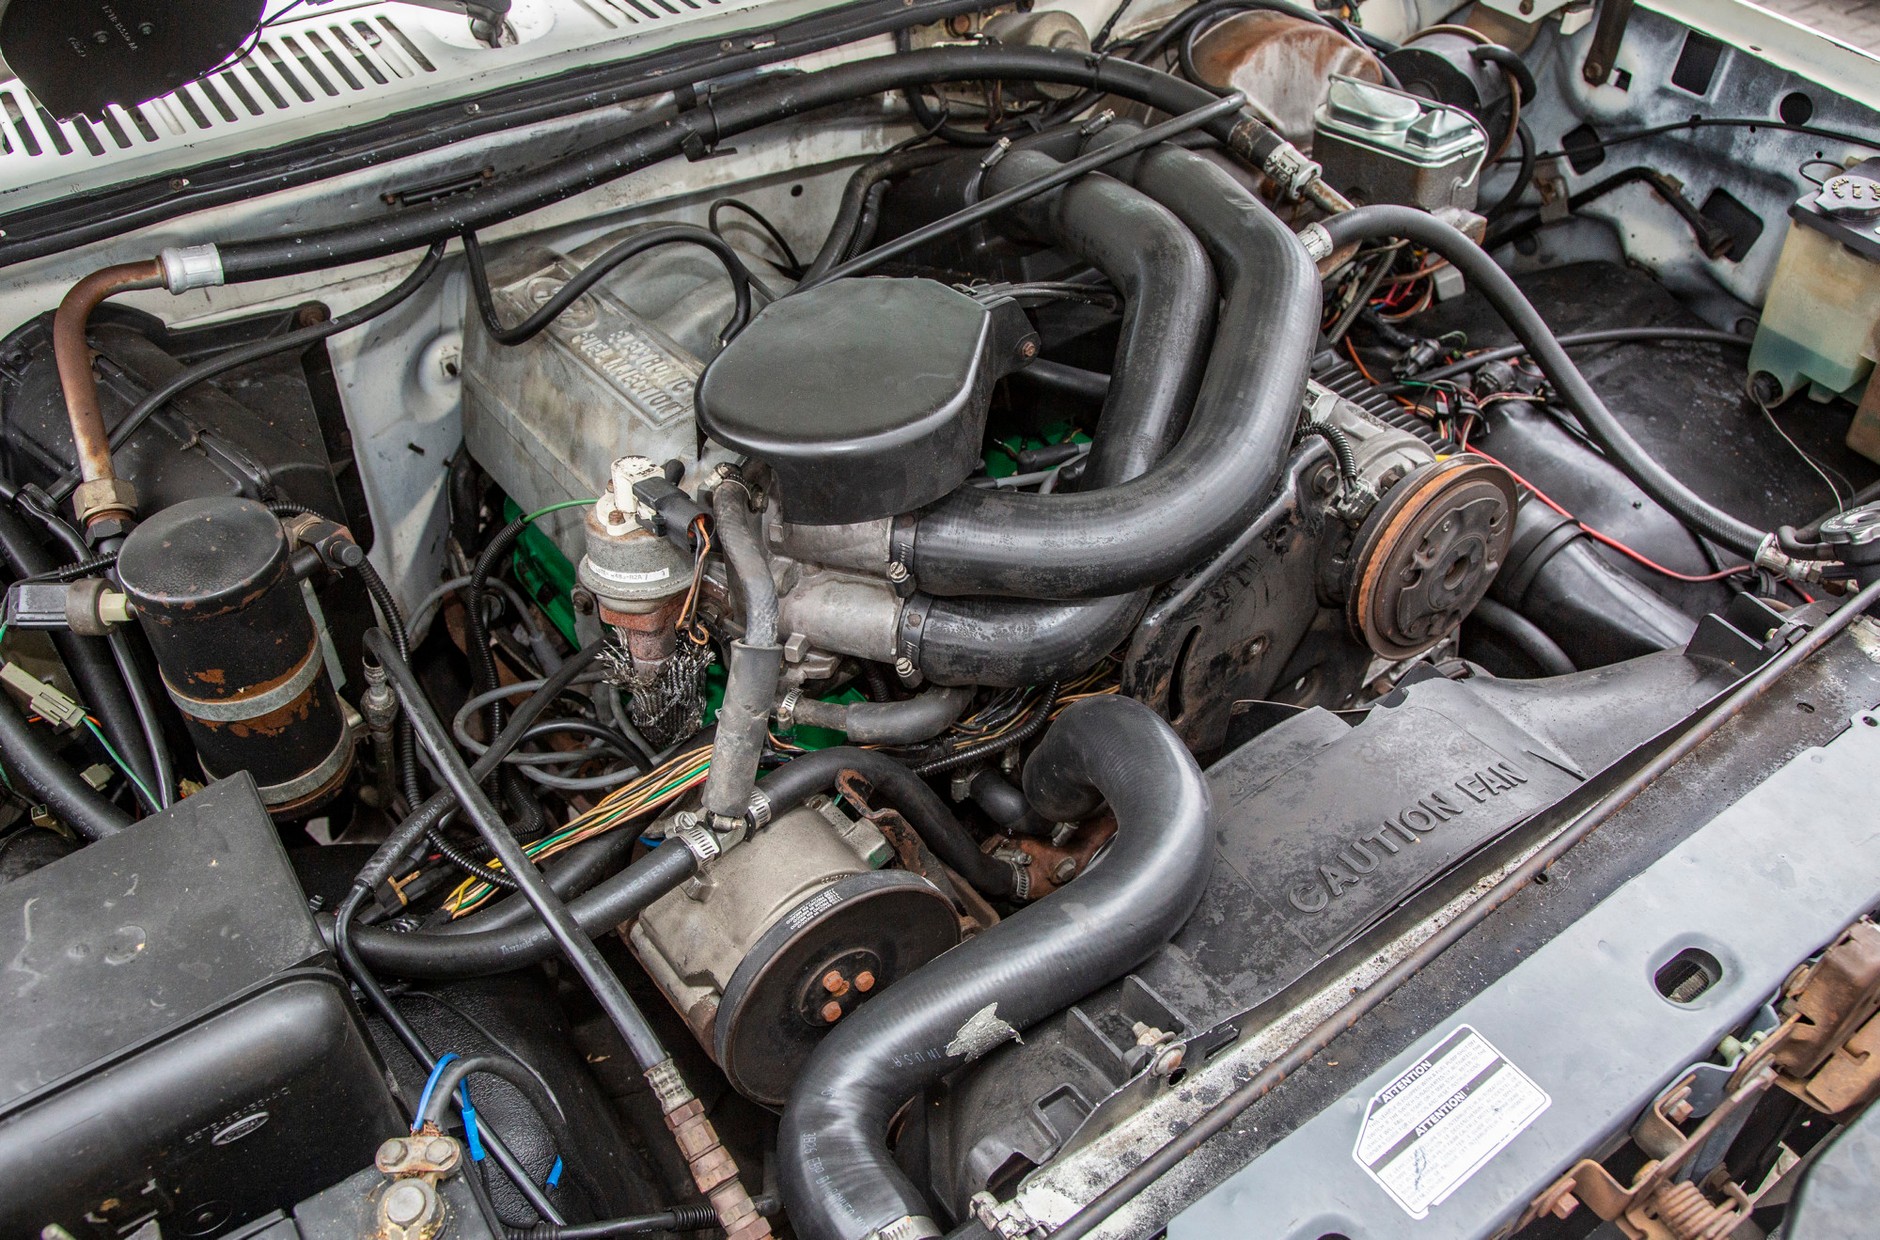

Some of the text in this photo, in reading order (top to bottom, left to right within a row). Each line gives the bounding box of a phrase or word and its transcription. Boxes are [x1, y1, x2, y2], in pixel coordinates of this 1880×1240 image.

[572, 331, 684, 419] FUEL INJECTION
[1288, 761, 1528, 914] CAUTION FAN
[625, 865, 666, 895] HEATER
[662, 848, 688, 870] HOSE
[927, 1048, 943, 1062] IN
[1381, 1059, 1433, 1103] ATTENTION
[1414, 1089, 1468, 1137] ATTENTION!
